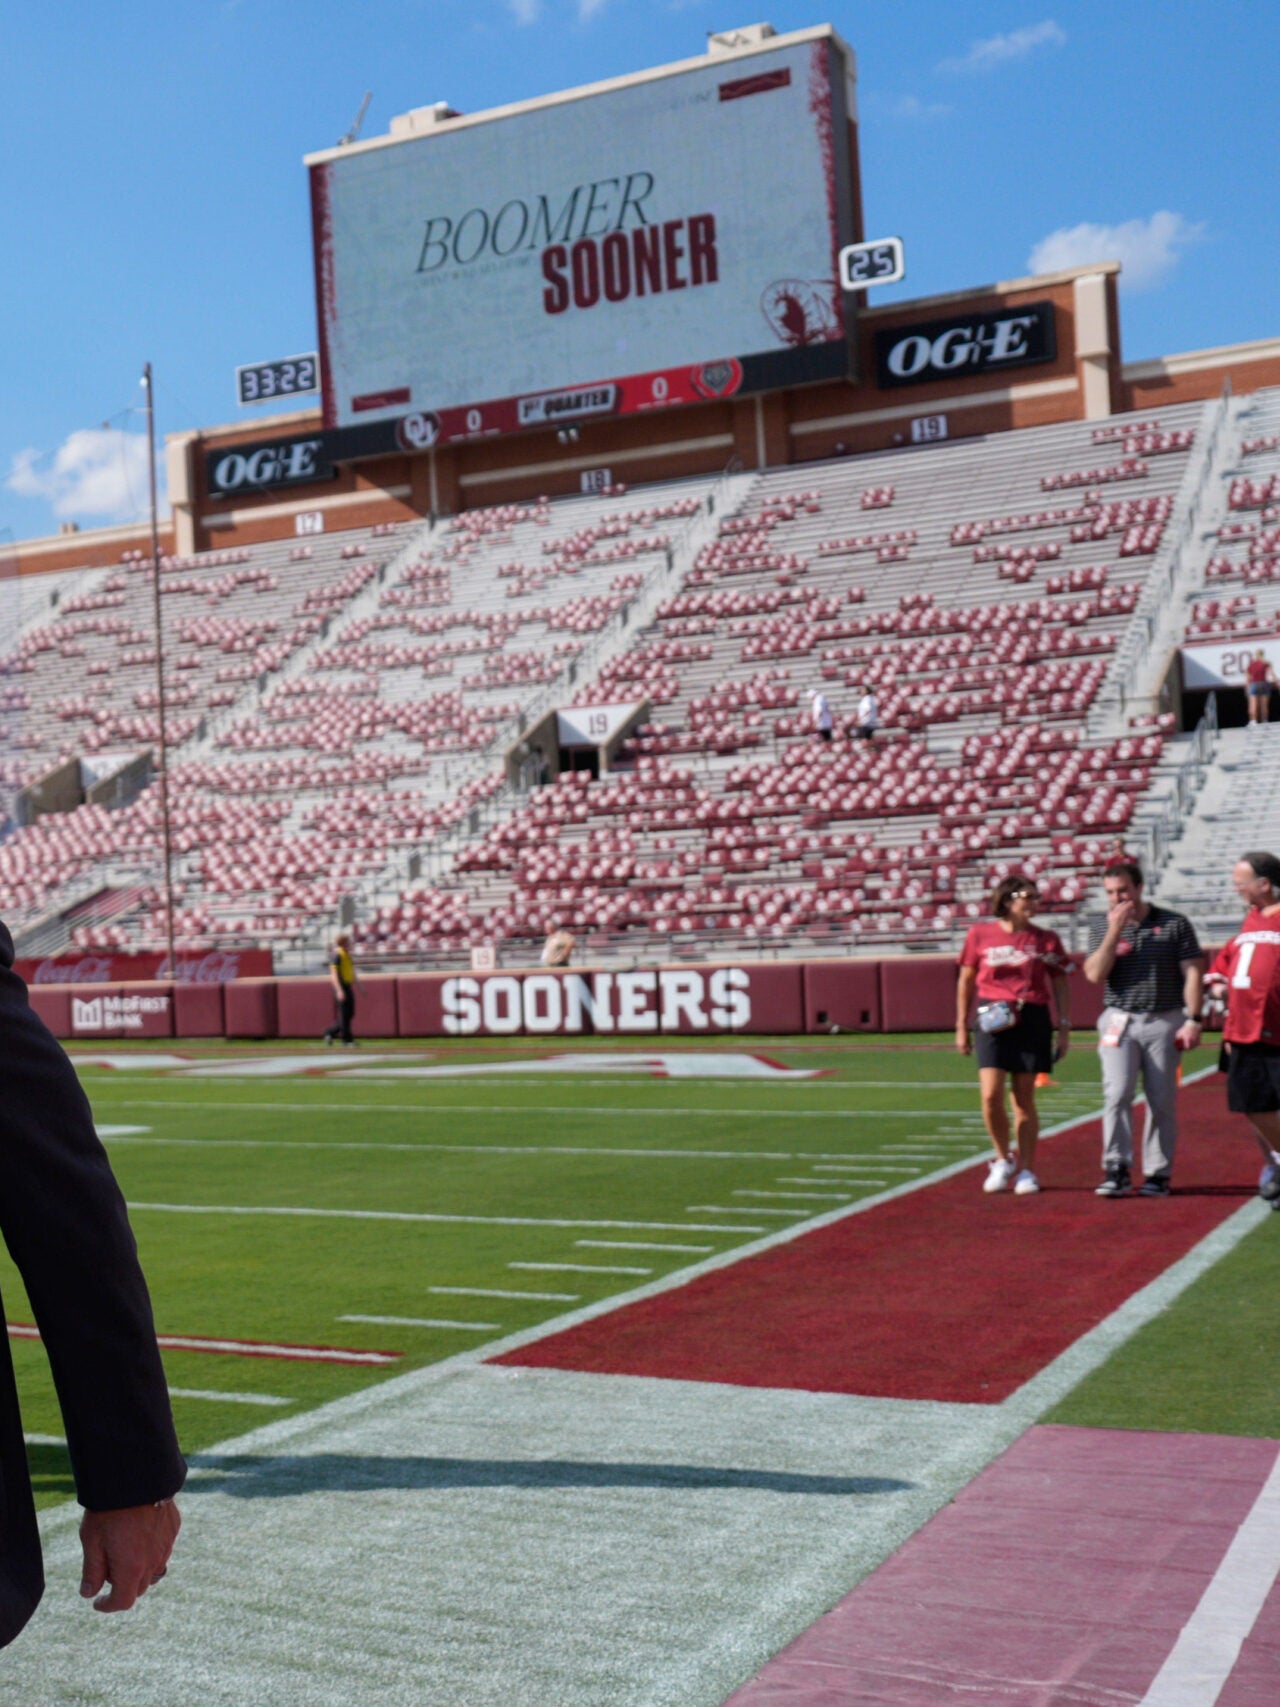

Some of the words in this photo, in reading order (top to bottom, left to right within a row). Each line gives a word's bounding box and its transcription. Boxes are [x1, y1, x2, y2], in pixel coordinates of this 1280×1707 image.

[415, 172, 654, 274] BOOMER
[541, 212, 718, 315] SOONER
[850, 249, 894, 282] 25
[652, 376, 667, 400] 0
[544, 388, 610, 416] QUARTER
[467, 409, 482, 431] 0
[920, 417, 940, 439] 19
[587, 470, 606, 489] 18
[1222, 651, 1252, 676] 20
[589, 713, 609, 735] 19
[1232, 942, 1255, 989] 1
[441, 968, 751, 1035] SOONERS
